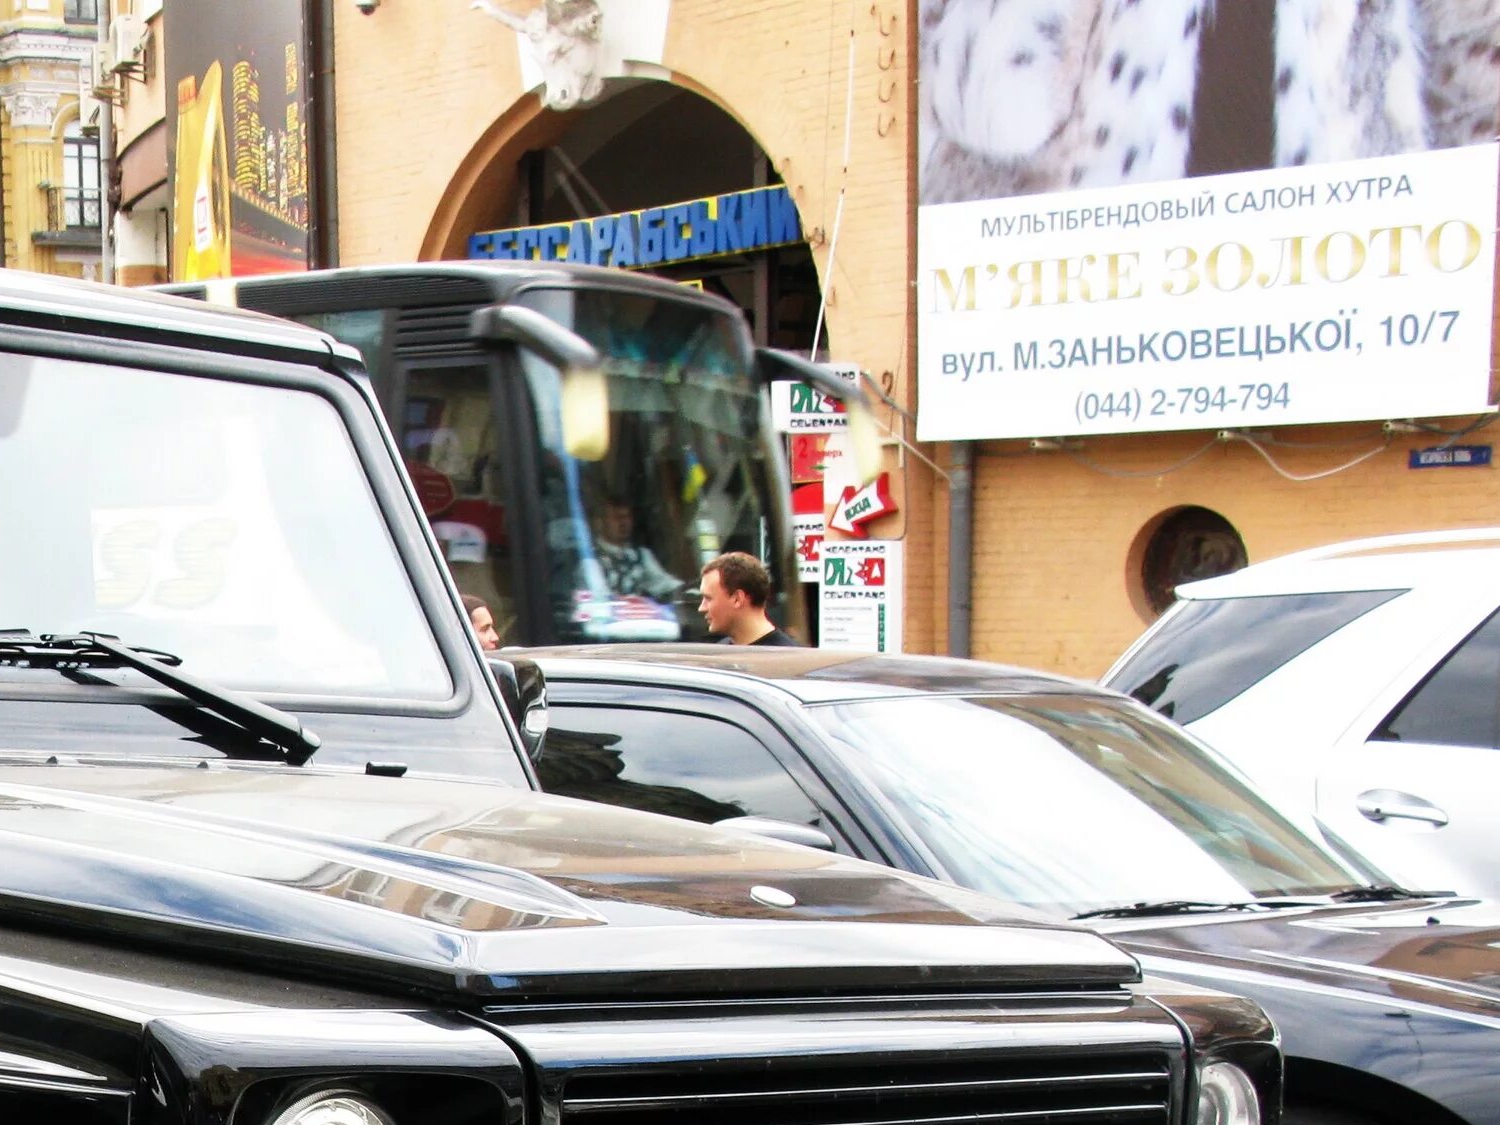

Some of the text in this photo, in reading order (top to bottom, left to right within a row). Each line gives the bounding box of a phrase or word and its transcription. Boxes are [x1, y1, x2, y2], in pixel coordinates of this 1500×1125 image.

[980, 174, 1413, 238] МУЛЬТІБРЕНДОВЫЙ САЛОН ХУТРА
[1163, 219, 1482, 297] ЗОЛОТО
[941, 350, 1004, 381] вул.
[1380, 311, 1460, 348] 10/7
[790, 418, 848, 428] CELENTAN
[1075, 382, 1290, 424] (044) 2-794-794
